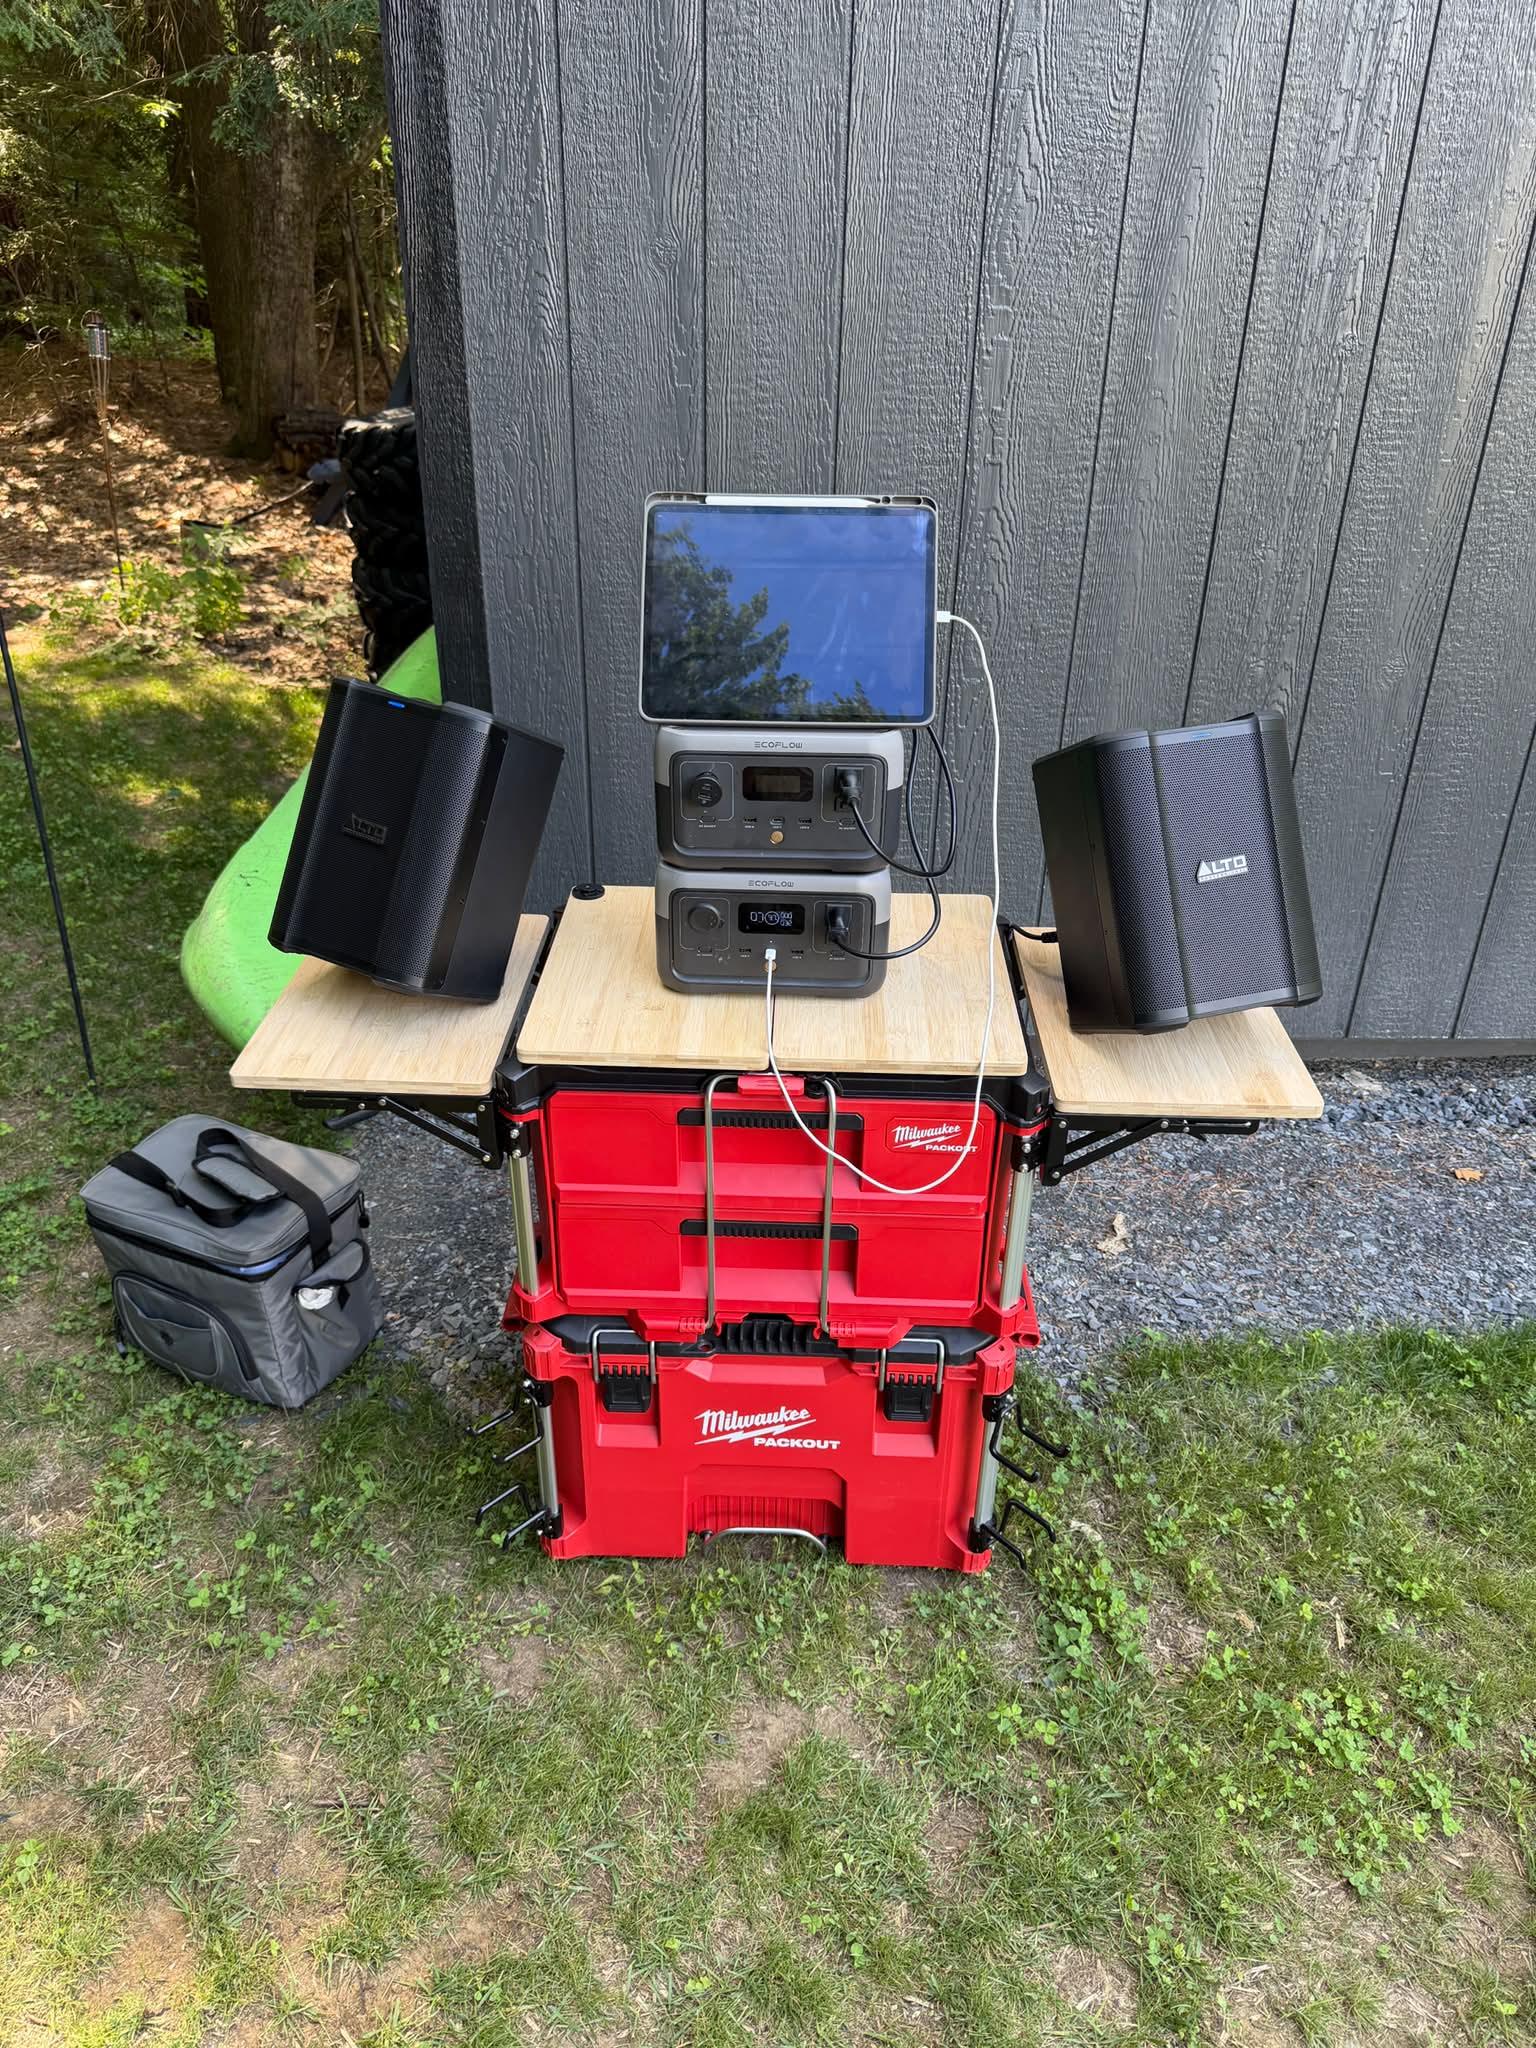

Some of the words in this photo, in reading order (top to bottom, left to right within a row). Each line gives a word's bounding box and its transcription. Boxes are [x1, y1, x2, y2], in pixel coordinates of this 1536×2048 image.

[753, 741, 803, 749] ECOFLOW
[1198, 855, 1247, 877] ALTO
[748, 879, 794, 888] ECOFLOW
[892, 1123, 961, 1143] Milwaukee
[694, 1406, 811, 1435] Milwaukee
[754, 1437, 841, 1450] PACKOUT
